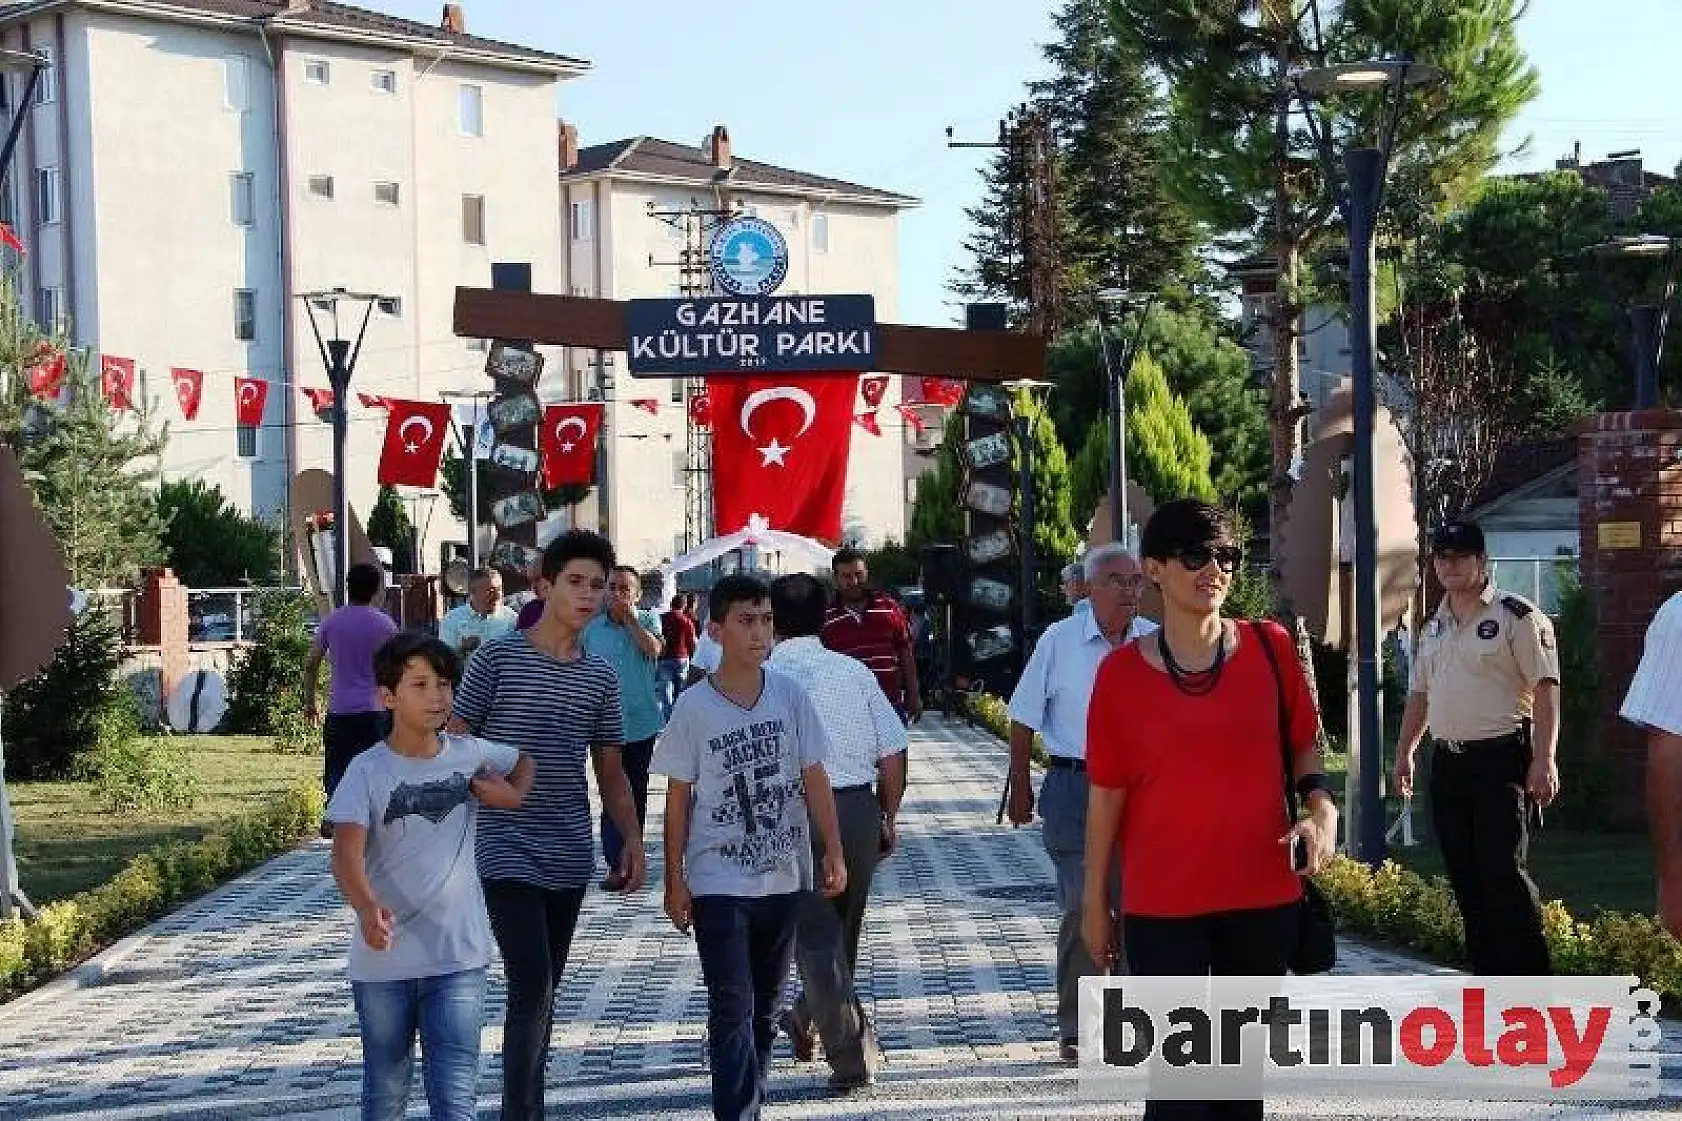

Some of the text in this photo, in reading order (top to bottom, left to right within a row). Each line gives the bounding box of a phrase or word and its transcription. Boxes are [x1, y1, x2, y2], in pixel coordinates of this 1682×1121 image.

[675, 300, 826, 327] GAZHANE
[632, 328, 872, 359] KÜLTÜR PARKI
[723, 735, 781, 768] JACKET
